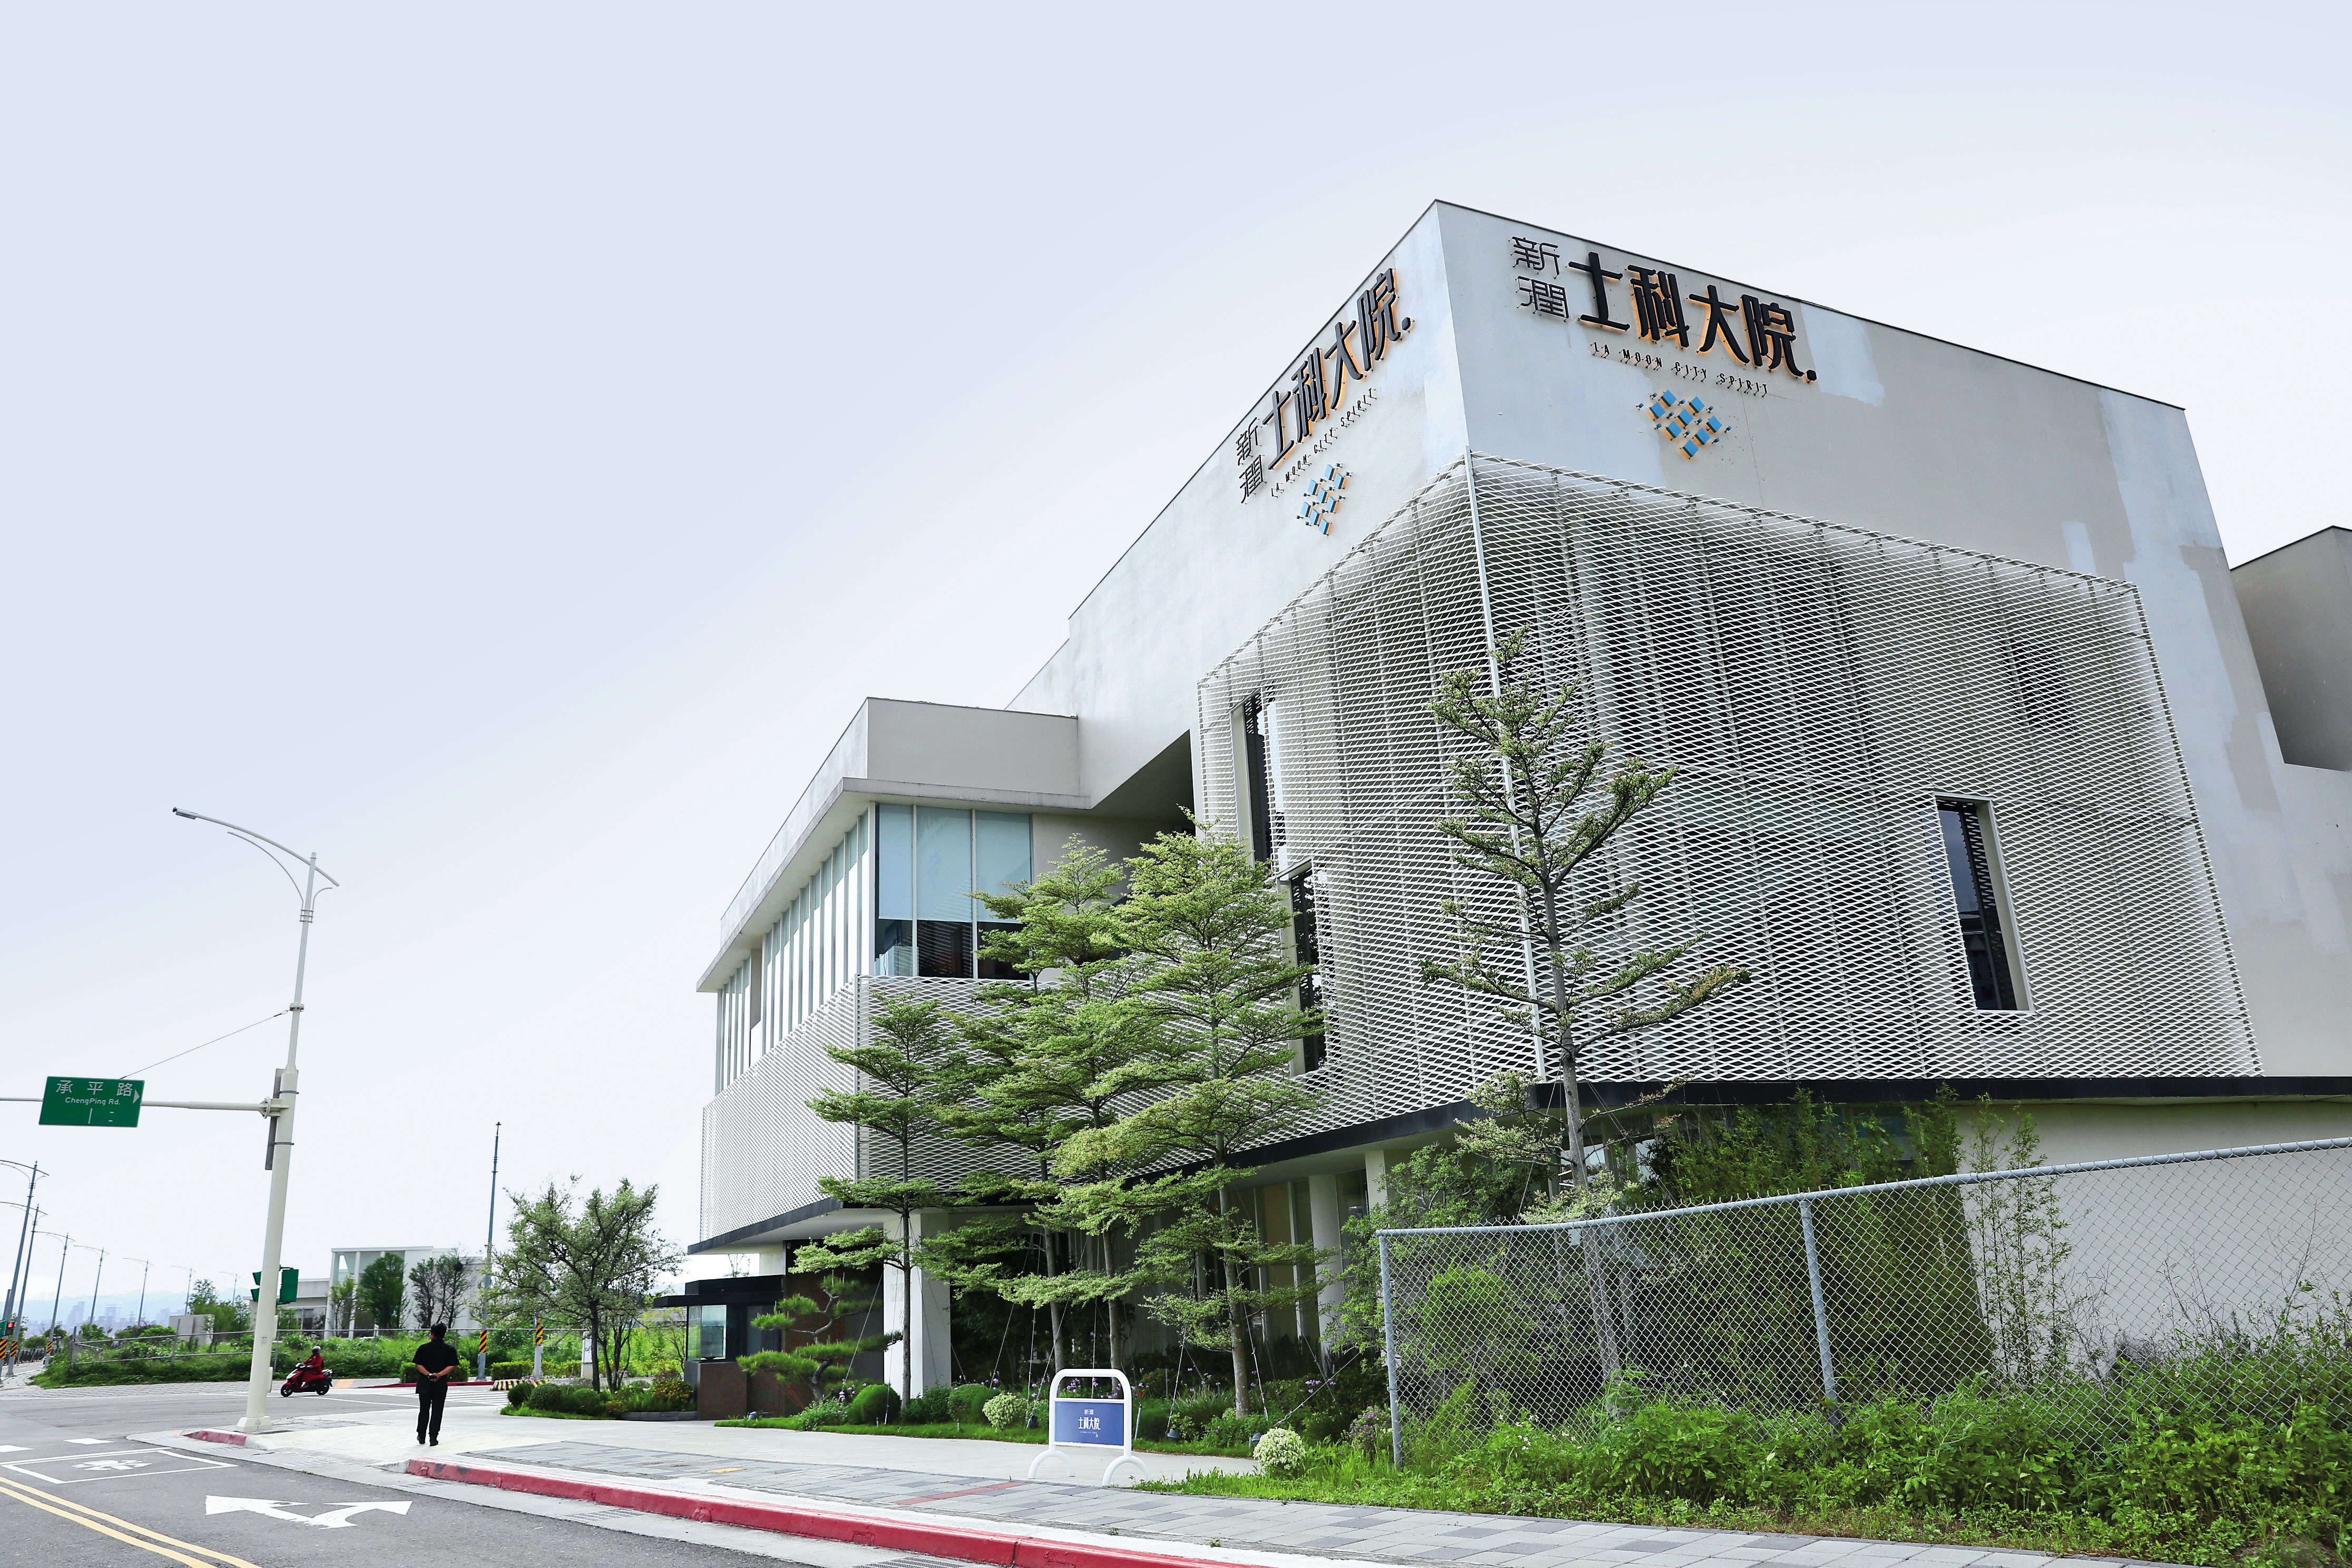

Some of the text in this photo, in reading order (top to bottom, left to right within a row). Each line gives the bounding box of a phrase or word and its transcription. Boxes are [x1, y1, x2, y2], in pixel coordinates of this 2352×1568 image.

[1622, 348, 1662, 368] MOON
[1675, 361, 1707, 377] CITY
[1719, 373, 1767, 394] SPIRIT
[1286, 454, 1308, 482] MOON
[1314, 427, 1333, 453] CITY
[1341, 388, 1372, 426] SPIRIT
[56, 1080, 133, 1096] 承平路
[65, 1097, 106, 1105] ChengPing
